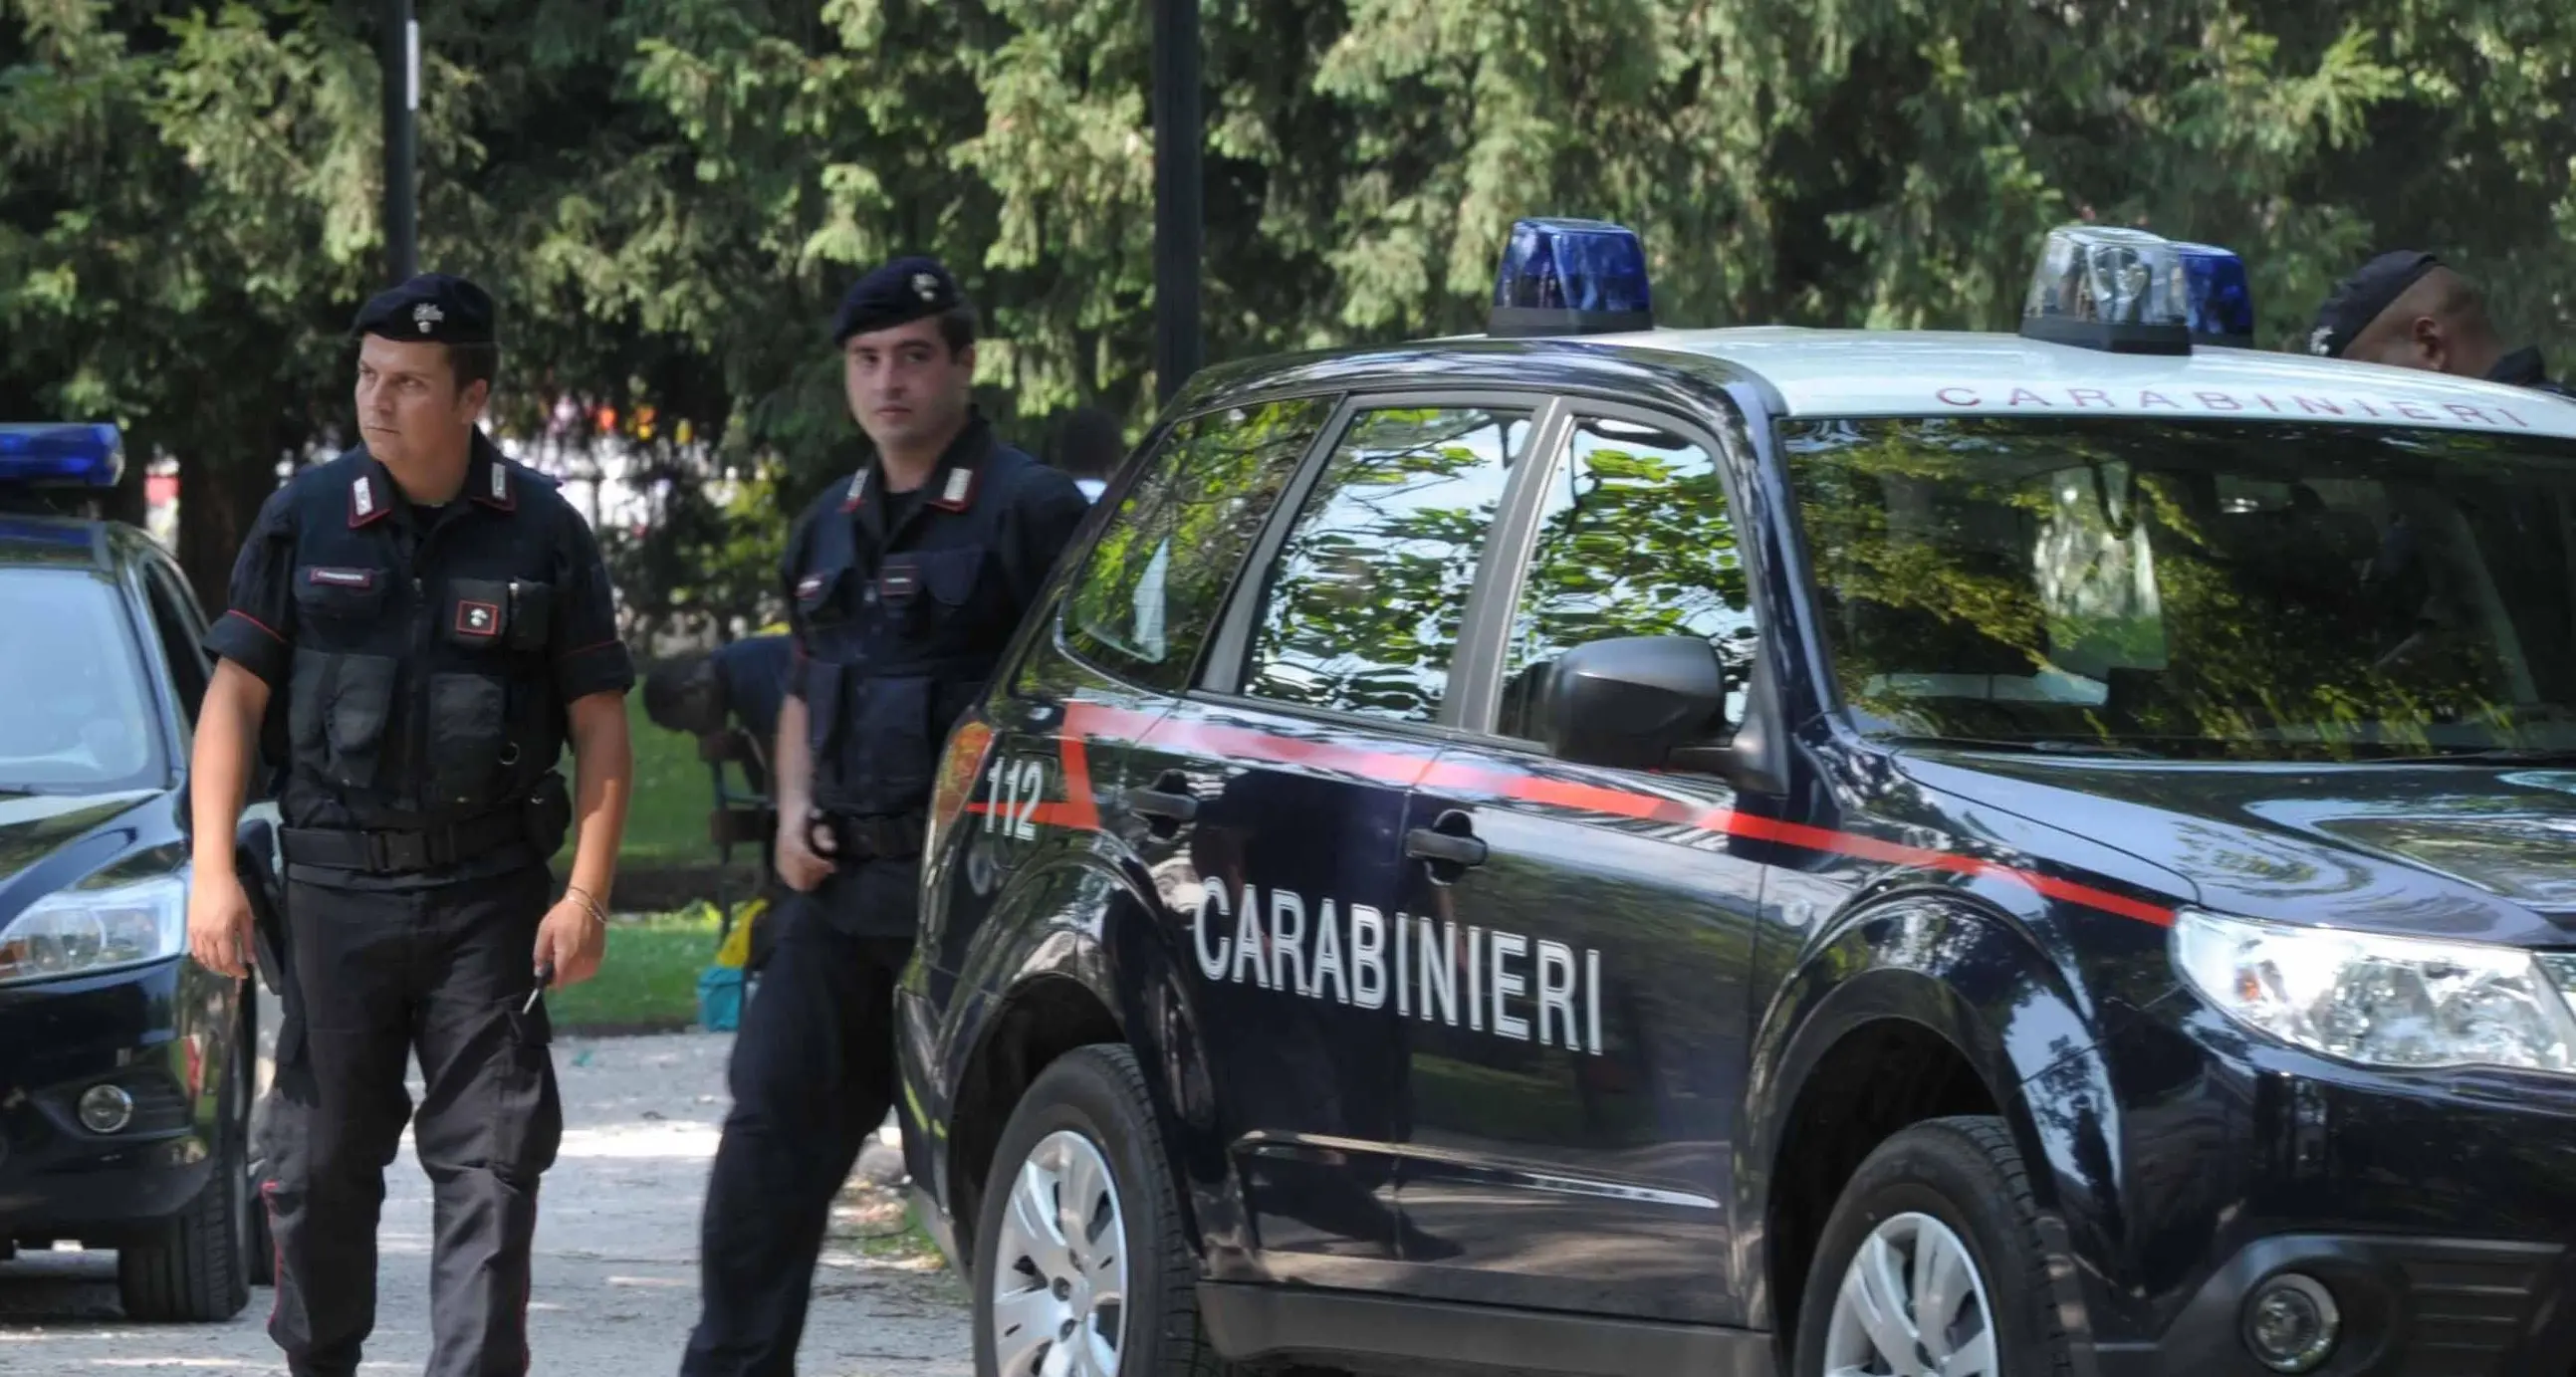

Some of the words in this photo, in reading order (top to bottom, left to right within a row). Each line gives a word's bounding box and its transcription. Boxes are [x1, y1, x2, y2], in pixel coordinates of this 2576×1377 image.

[1936, 387, 2529, 428] CARABINIERI
[984, 756, 1043, 841] 112
[1195, 875, 1603, 1056] CARABINIERI
